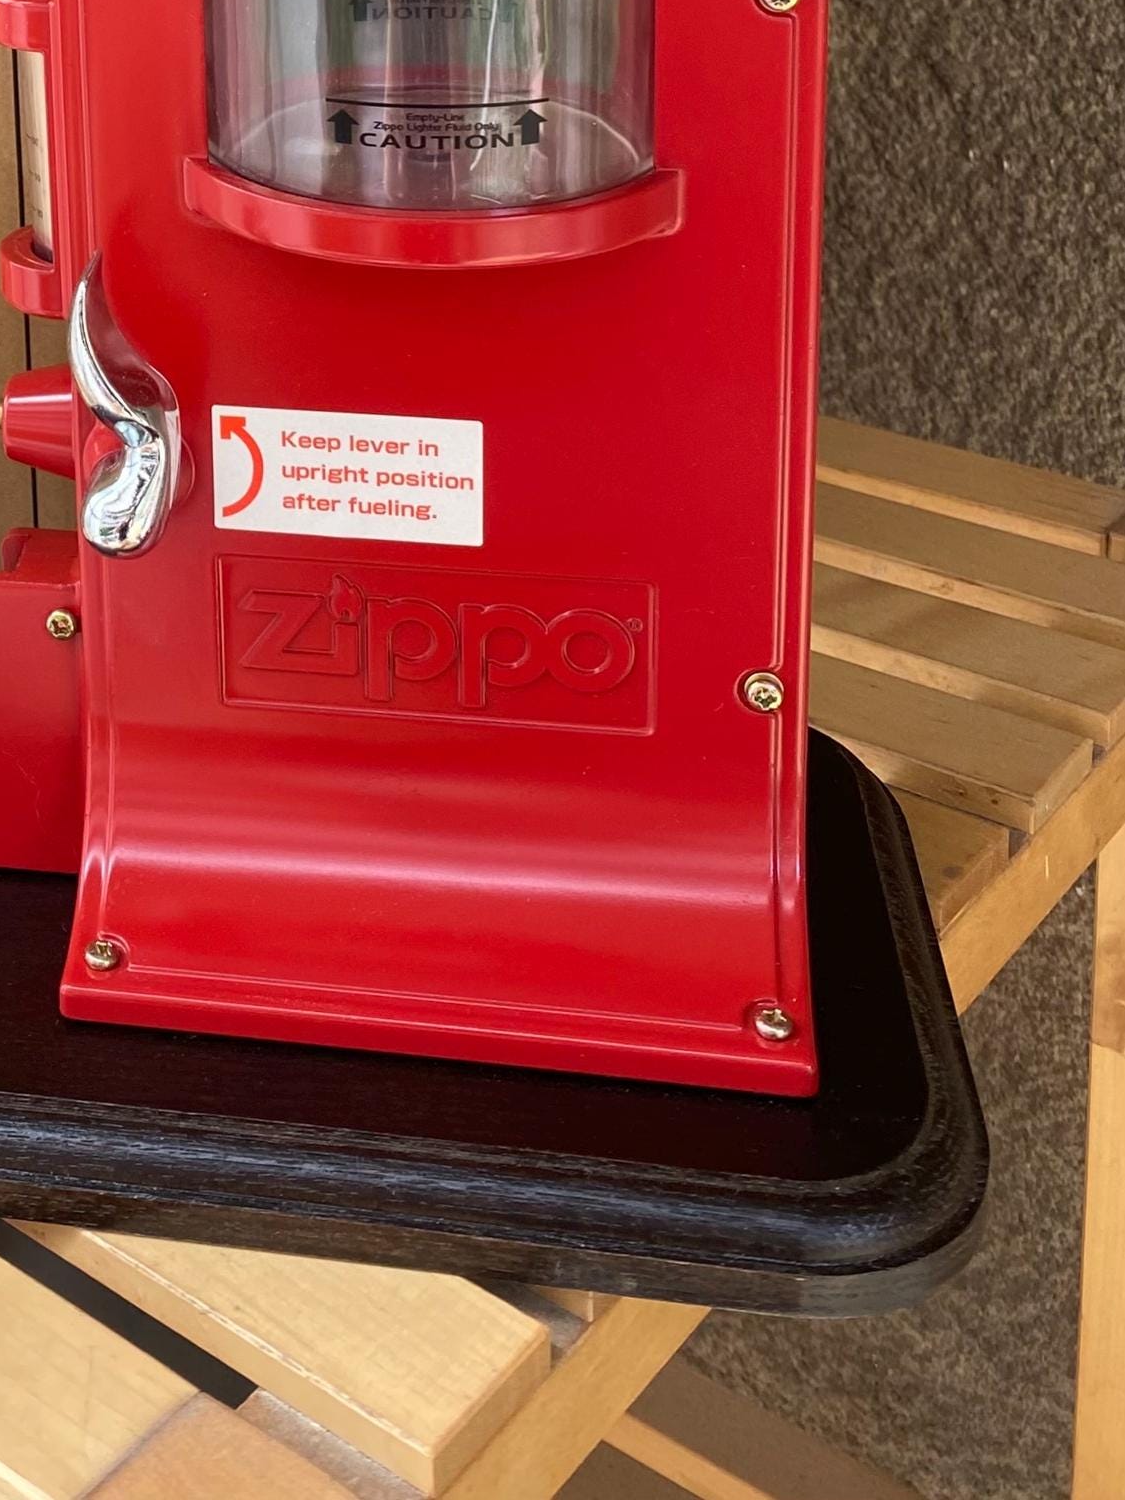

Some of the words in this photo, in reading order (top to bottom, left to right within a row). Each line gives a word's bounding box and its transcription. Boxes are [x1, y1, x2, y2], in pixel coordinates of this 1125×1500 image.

[373, 121, 403, 132] Zippo
[445, 123, 471, 132] Fluid
[359, 132, 514, 150] CAUTION
[281, 430, 340, 453] Keep
[349, 435, 410, 455] lever
[418, 439, 439, 457] in
[282, 464, 369, 484] upright
[376, 470, 474, 490] position
[282, 493, 341, 512] after
[348, 498, 438, 521] fueling.
